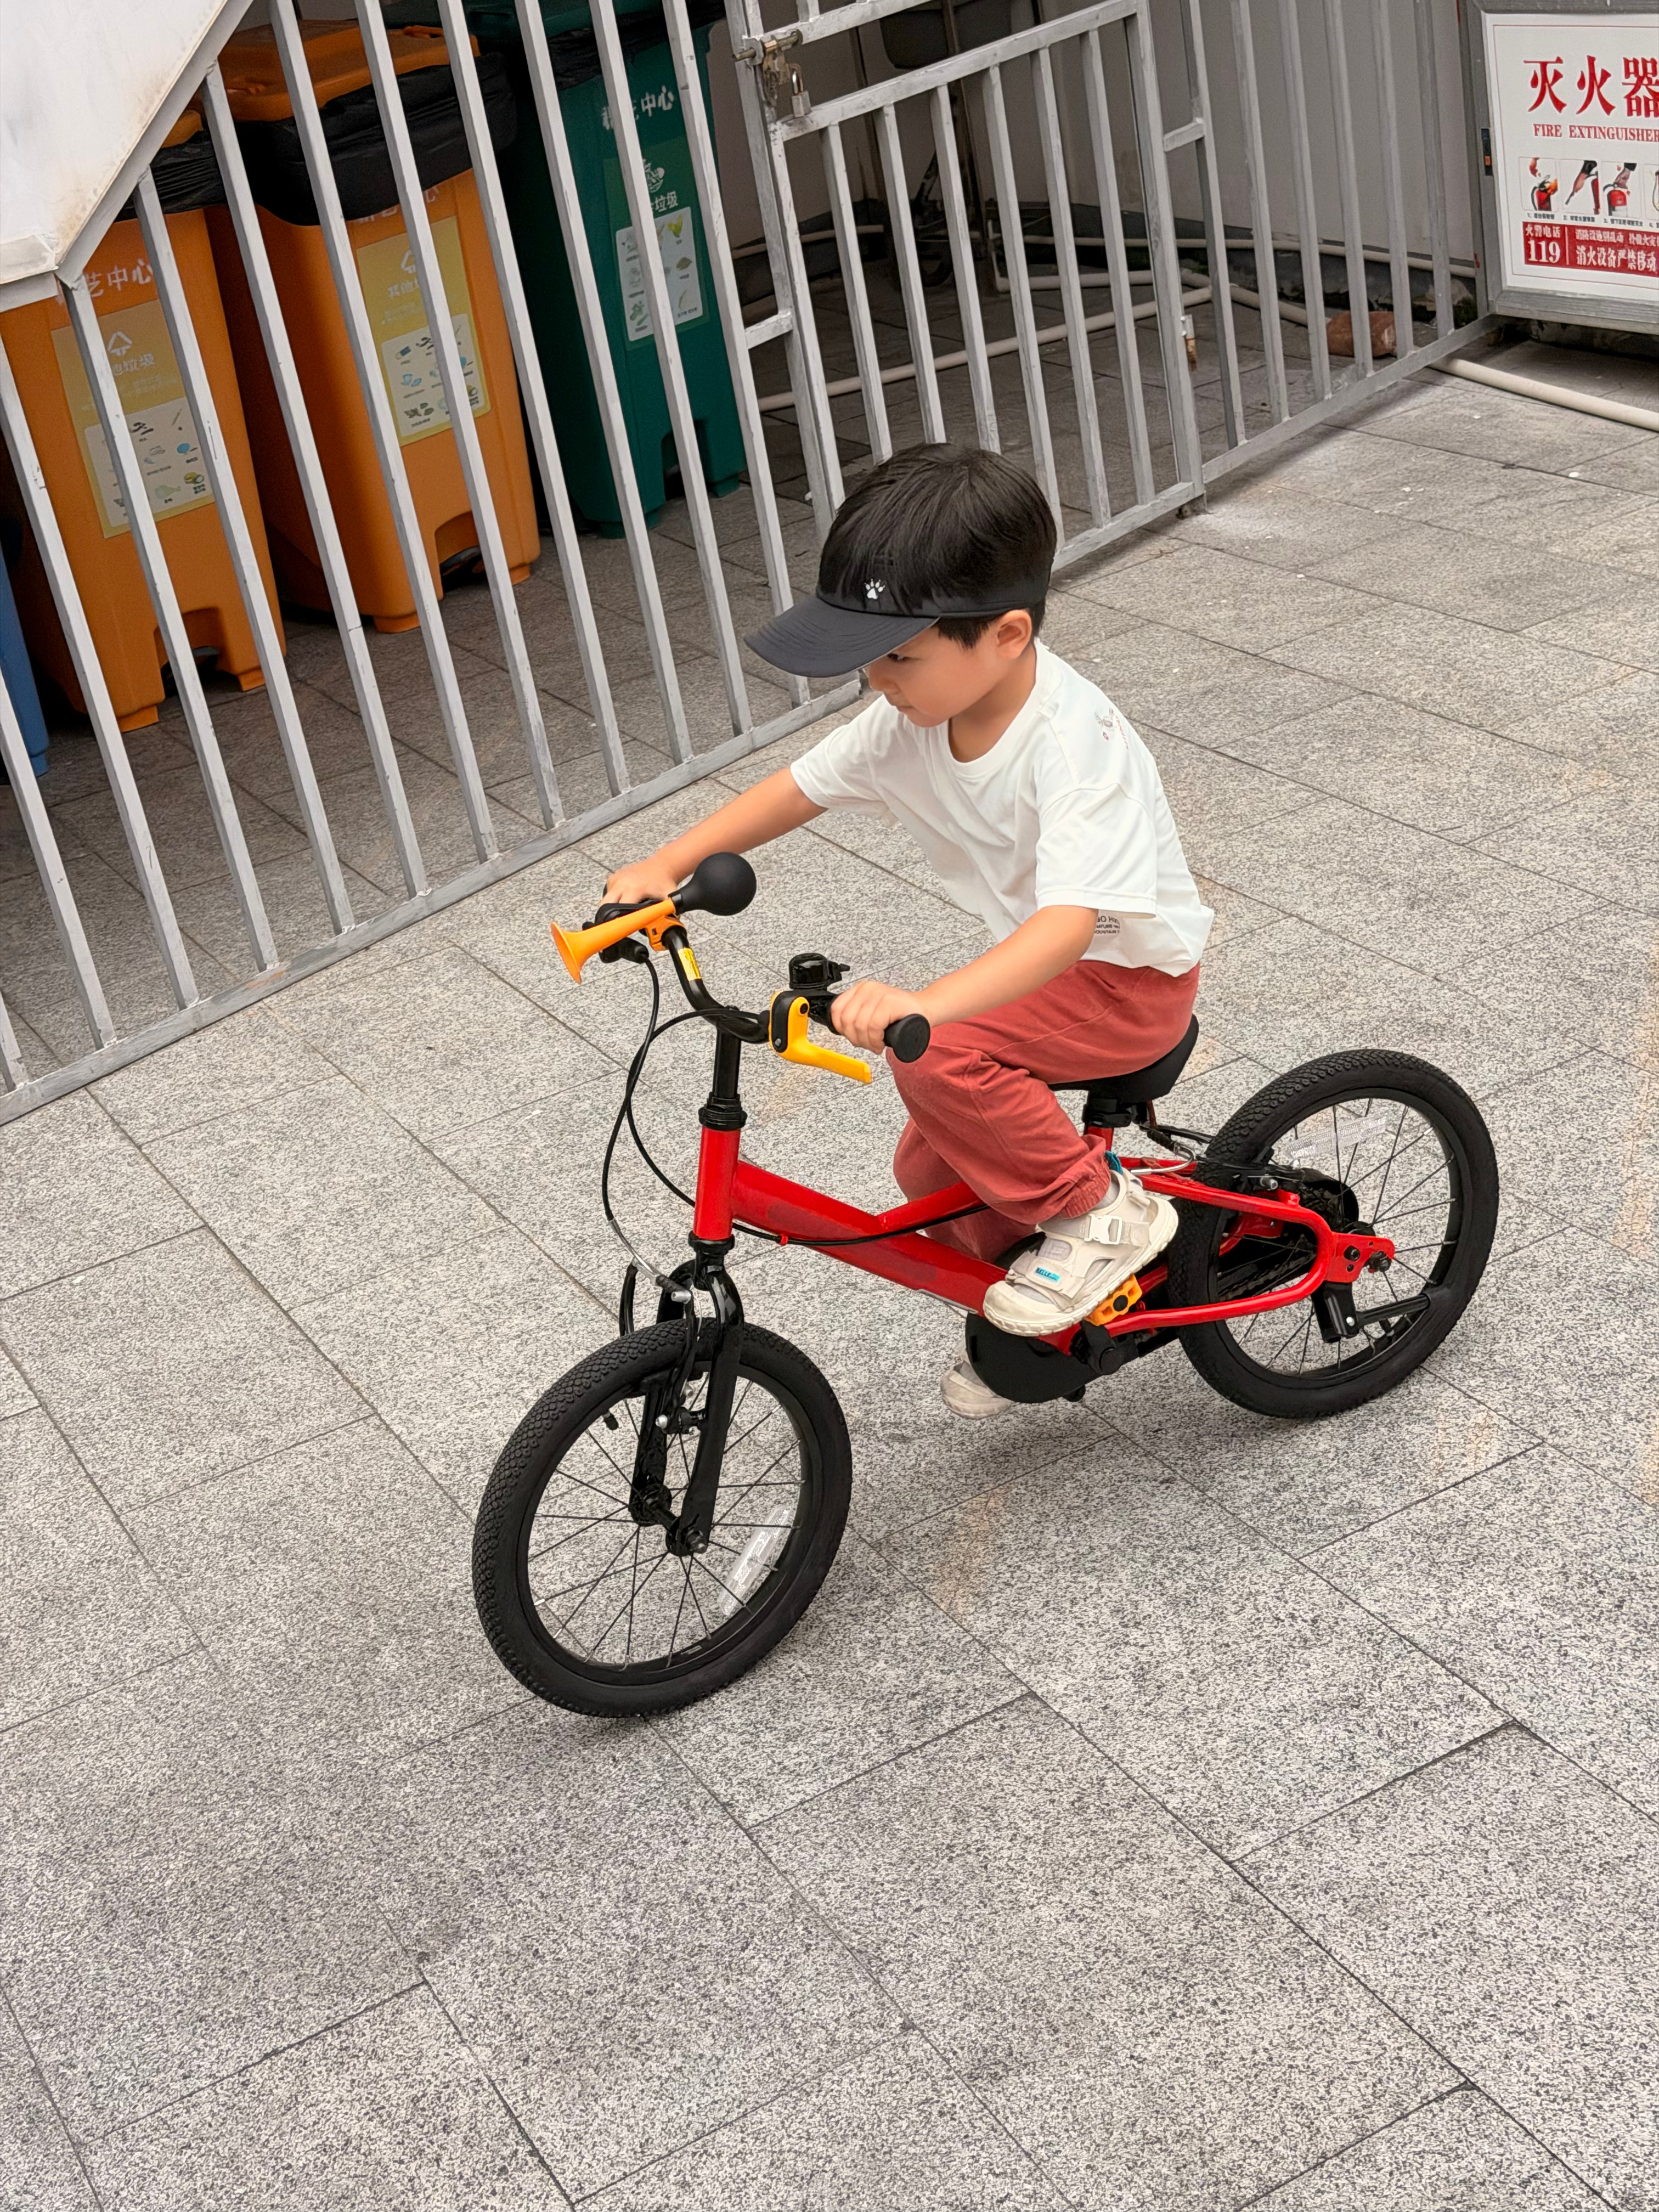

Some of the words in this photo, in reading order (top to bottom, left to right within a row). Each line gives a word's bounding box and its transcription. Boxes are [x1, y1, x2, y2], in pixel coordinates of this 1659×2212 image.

[1523, 55, 1659, 117] 灭火器
[1533, 124, 1562, 137] FIRE
[651, 191, 679, 212] 垃圾
[1527, 239, 1561, 263] 119
